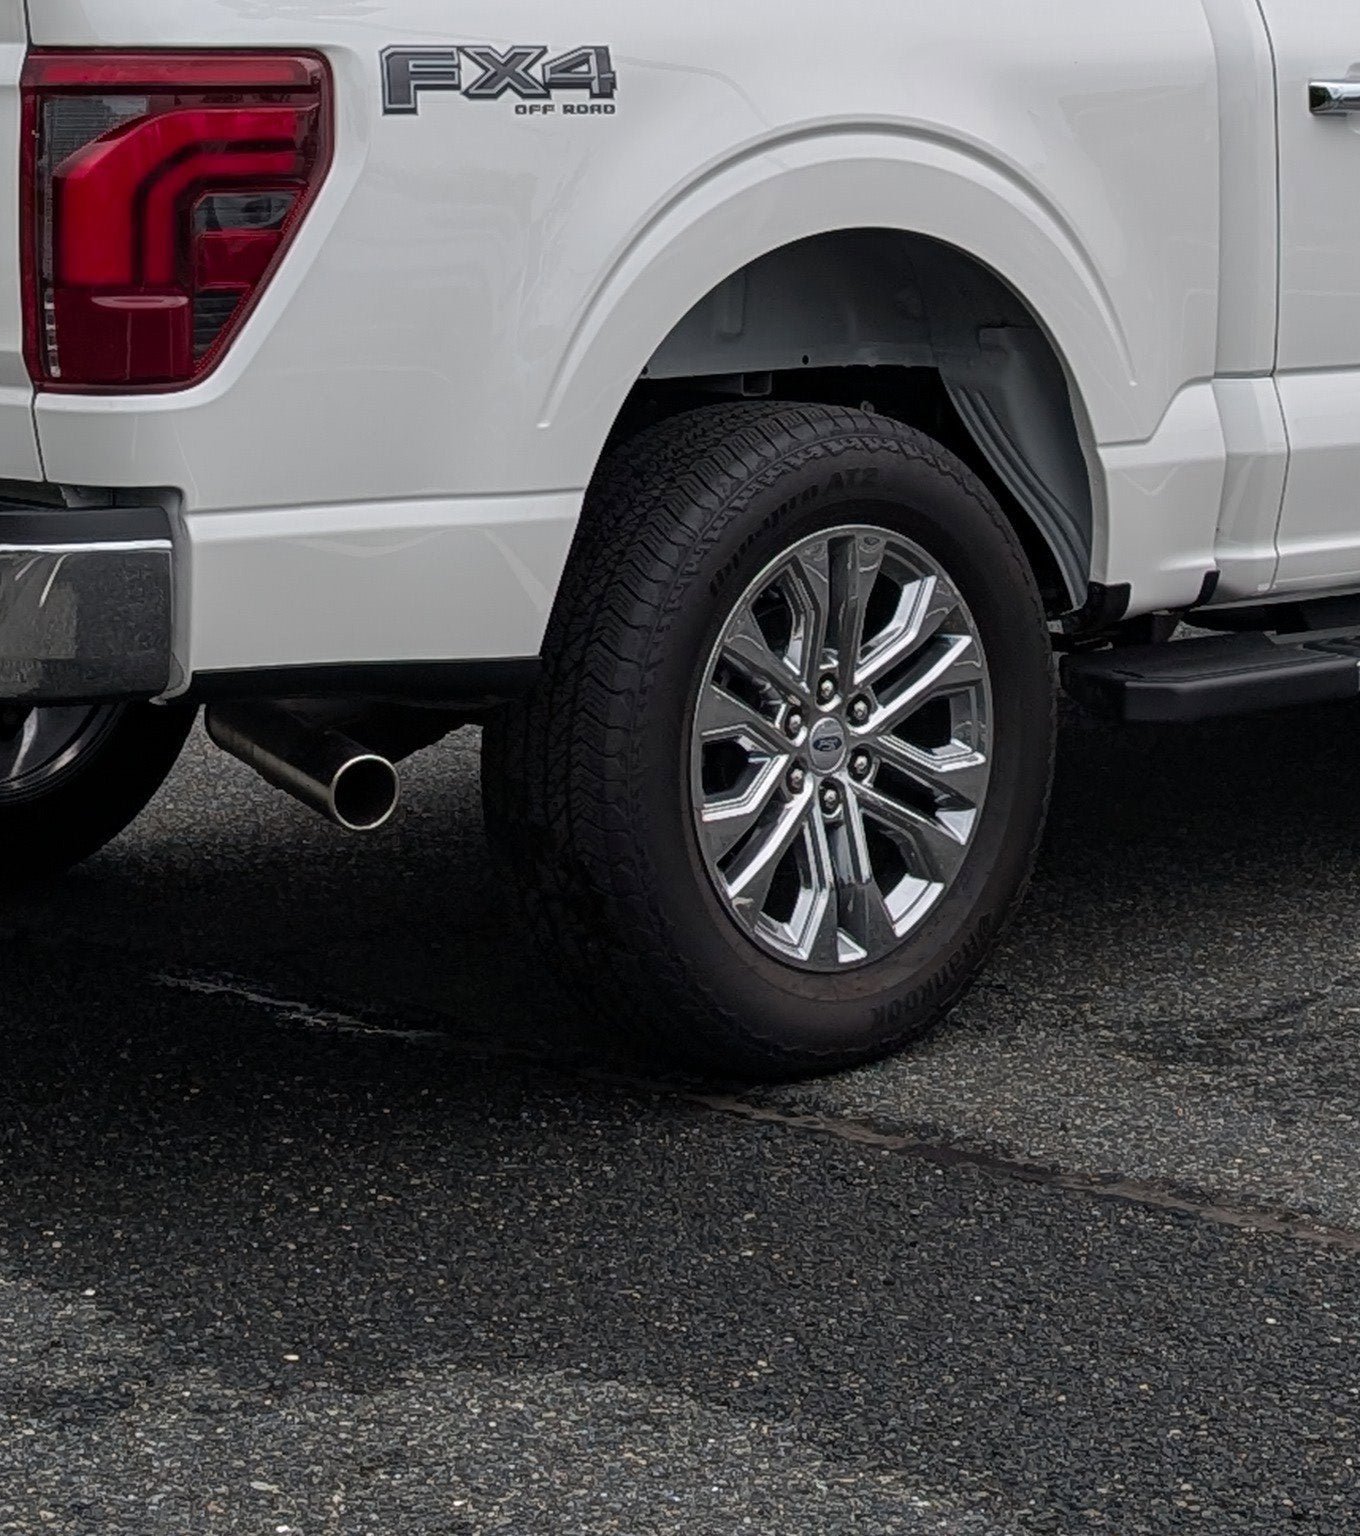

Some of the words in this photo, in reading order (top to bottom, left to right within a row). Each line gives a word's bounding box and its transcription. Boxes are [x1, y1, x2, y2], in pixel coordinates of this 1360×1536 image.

[379, 44, 618, 115] FX4
[515, 104, 555, 115] OFF
[562, 104, 616, 115] ROAD
